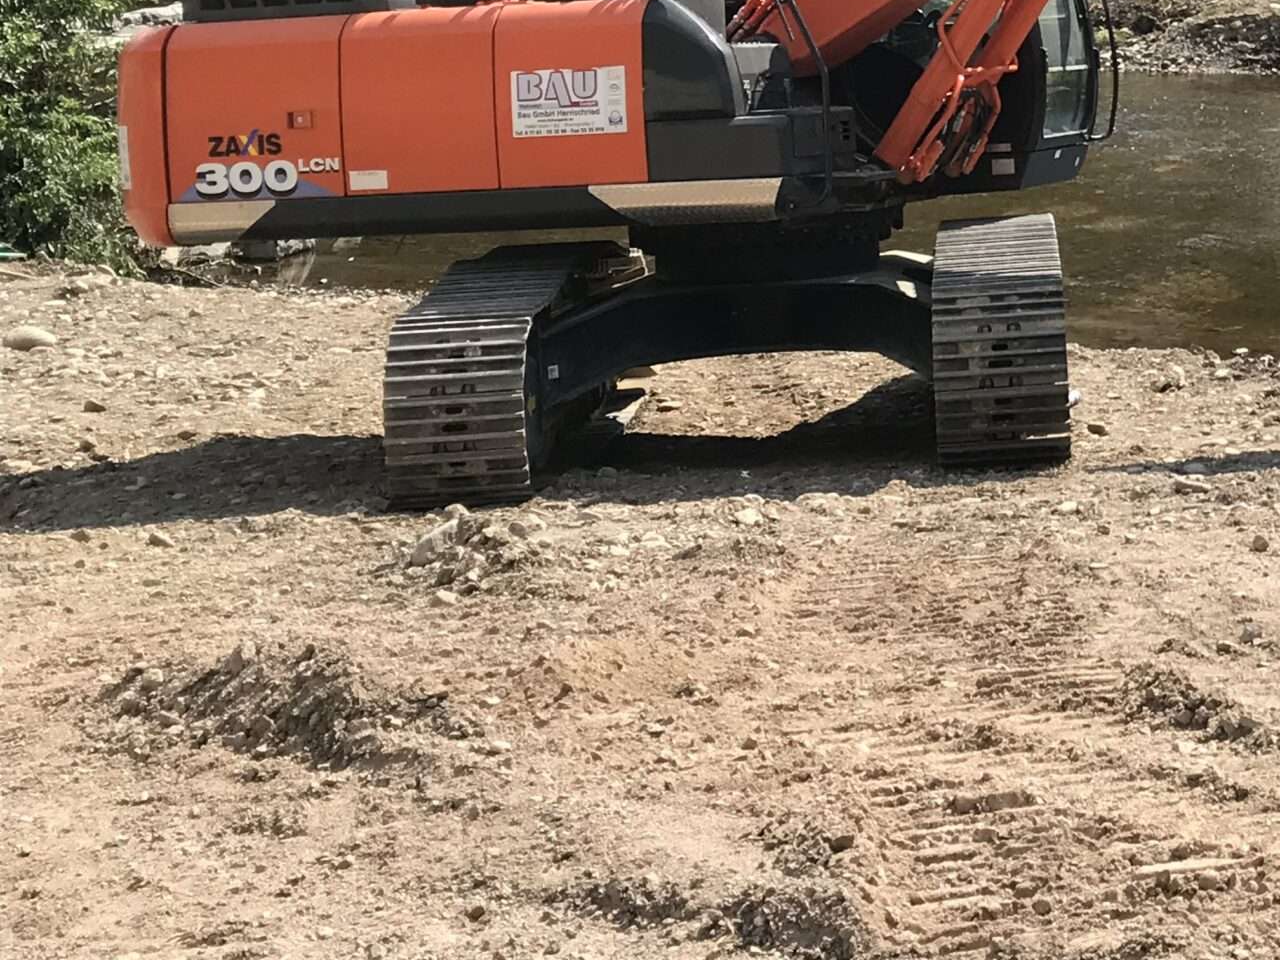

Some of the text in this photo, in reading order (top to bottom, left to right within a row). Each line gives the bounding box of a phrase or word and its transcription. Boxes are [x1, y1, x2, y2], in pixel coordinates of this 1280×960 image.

[516, 69, 598, 108] BAU
[207, 129, 282, 157] ZAXIS
[194, 157, 341, 198] 300 LCN
